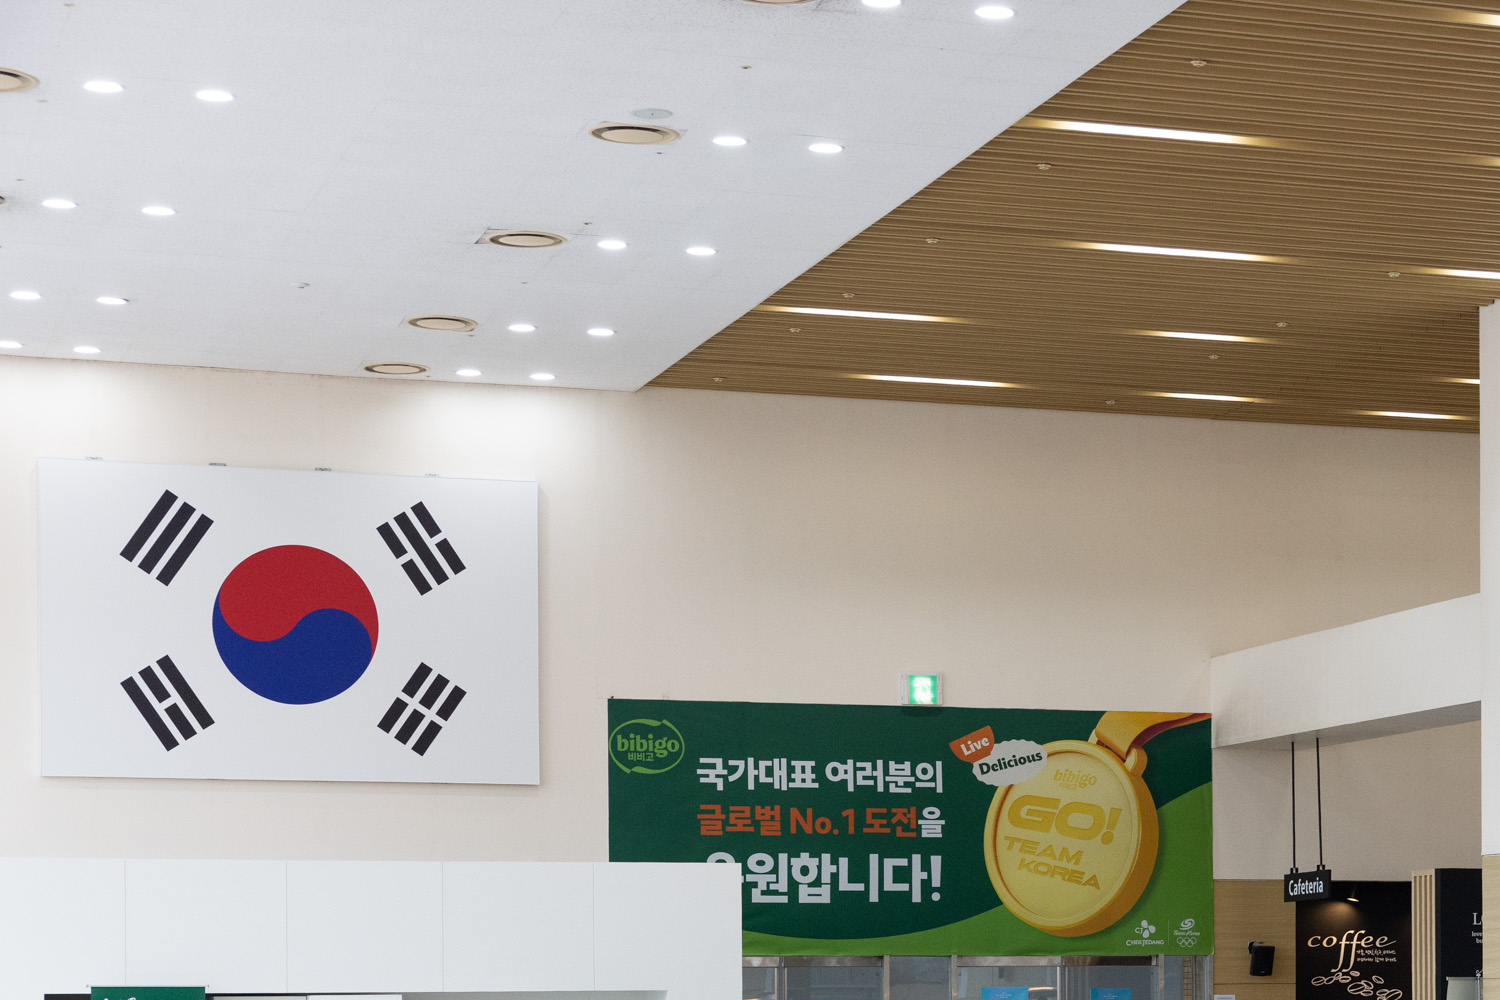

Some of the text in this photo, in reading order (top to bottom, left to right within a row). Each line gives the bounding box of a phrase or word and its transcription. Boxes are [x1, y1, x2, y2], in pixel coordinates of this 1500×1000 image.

[616, 733, 680, 758] bibigo
[627, 752, 654, 762] 비비고
[960, 737, 990, 757] Live
[697, 757, 943, 793] 국가대표 여러분의
[978, 752, 1043, 776] Delicious
[1053, 769, 1097, 789] bibigo
[697, 804, 945, 838] 글로벌 No.1 도전을
[1008, 795, 1122, 845] GO!
[1004, 836, 1083, 866] TEAM
[706, 852, 942, 904] 원합니다!
[1018, 858, 1100, 890] KOREA
[1288, 877, 1324, 896] Cafeteria
[1307, 930, 1397, 973] coffee
